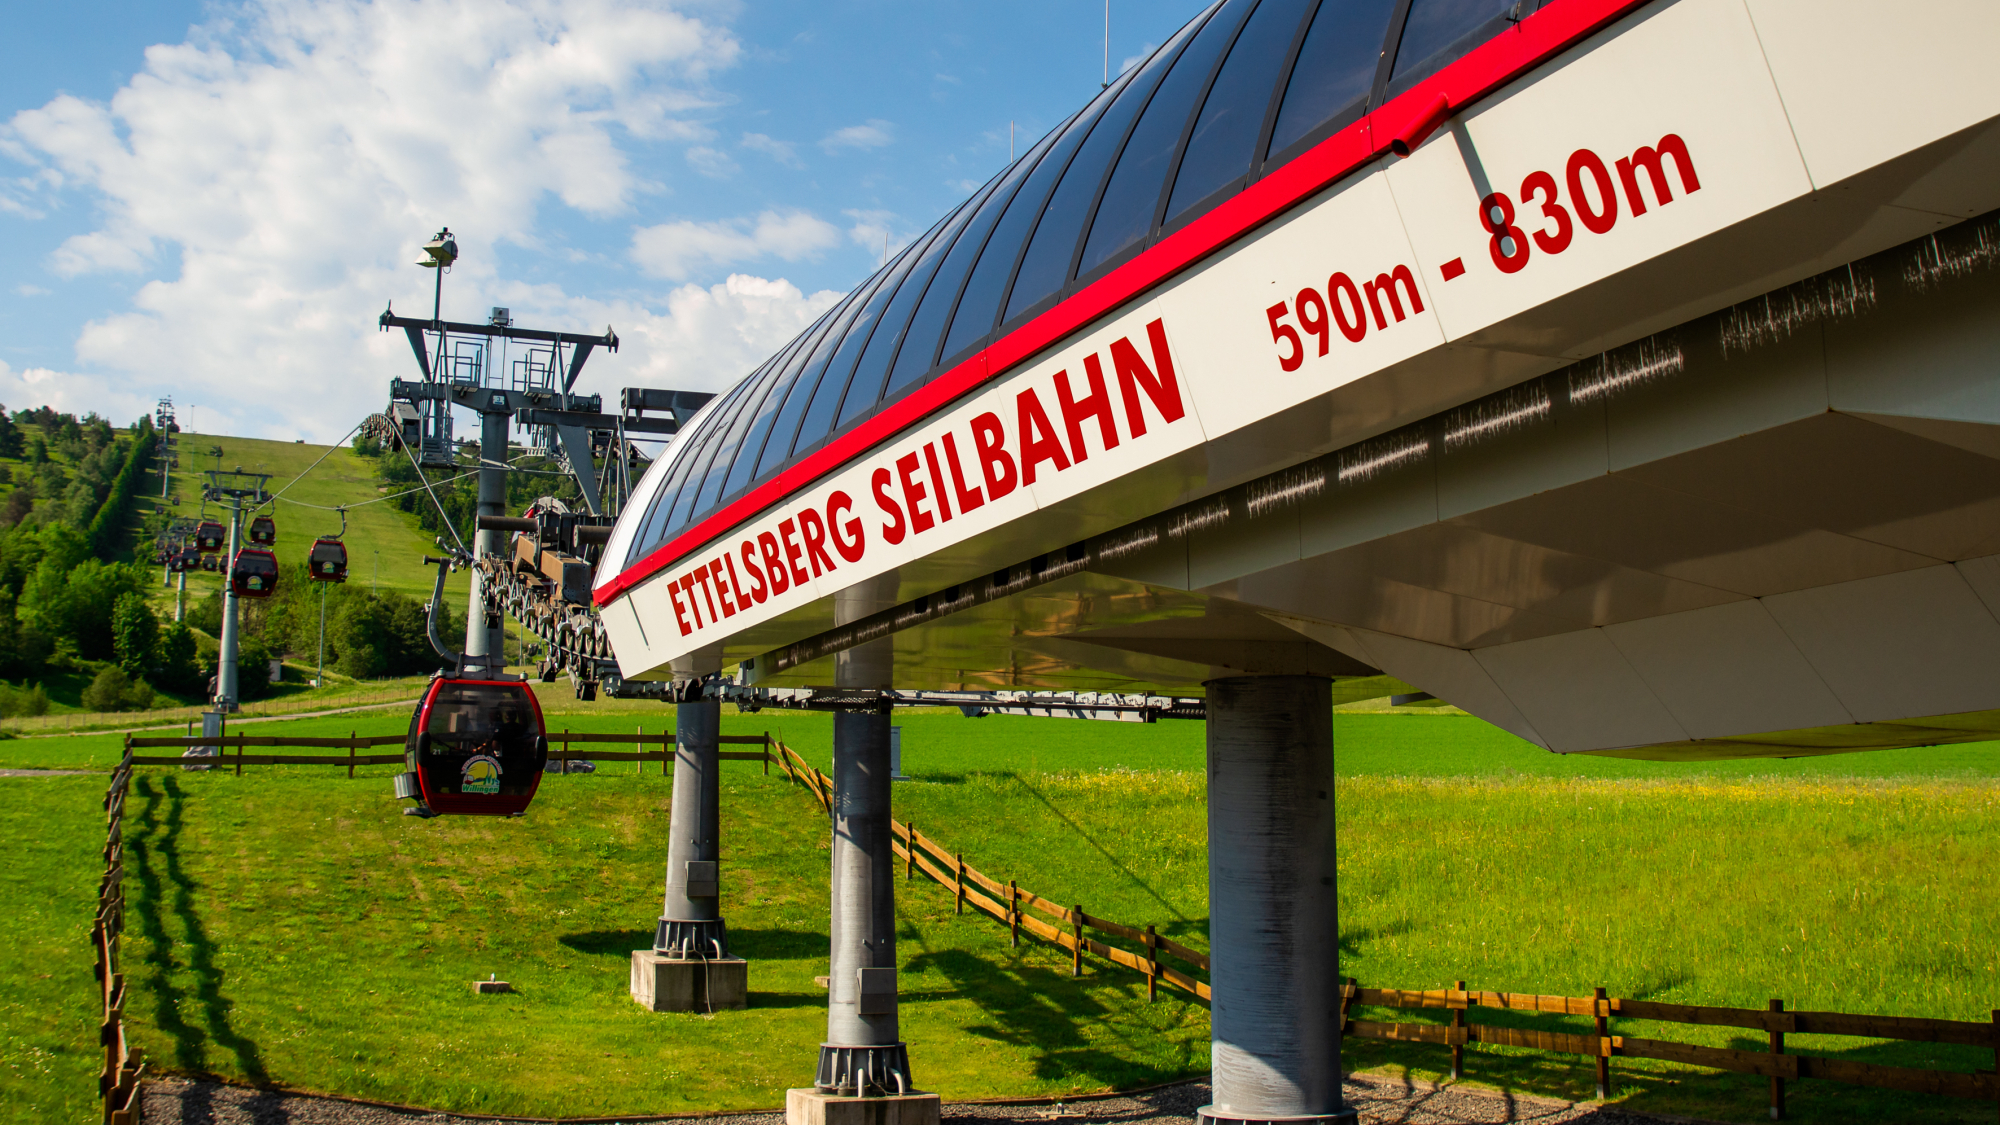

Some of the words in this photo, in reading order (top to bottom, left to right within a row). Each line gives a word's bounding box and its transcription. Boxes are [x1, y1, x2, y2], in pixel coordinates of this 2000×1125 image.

[1266, 264, 1425, 372] 590m
[1440, 257, 1466, 282] -
[1479, 133, 1701, 274] 830m
[667, 490, 865, 637] ETTELSBERG
[871, 317, 1185, 545] SEILBAHN
[462, 784, 499, 794] Willingen
